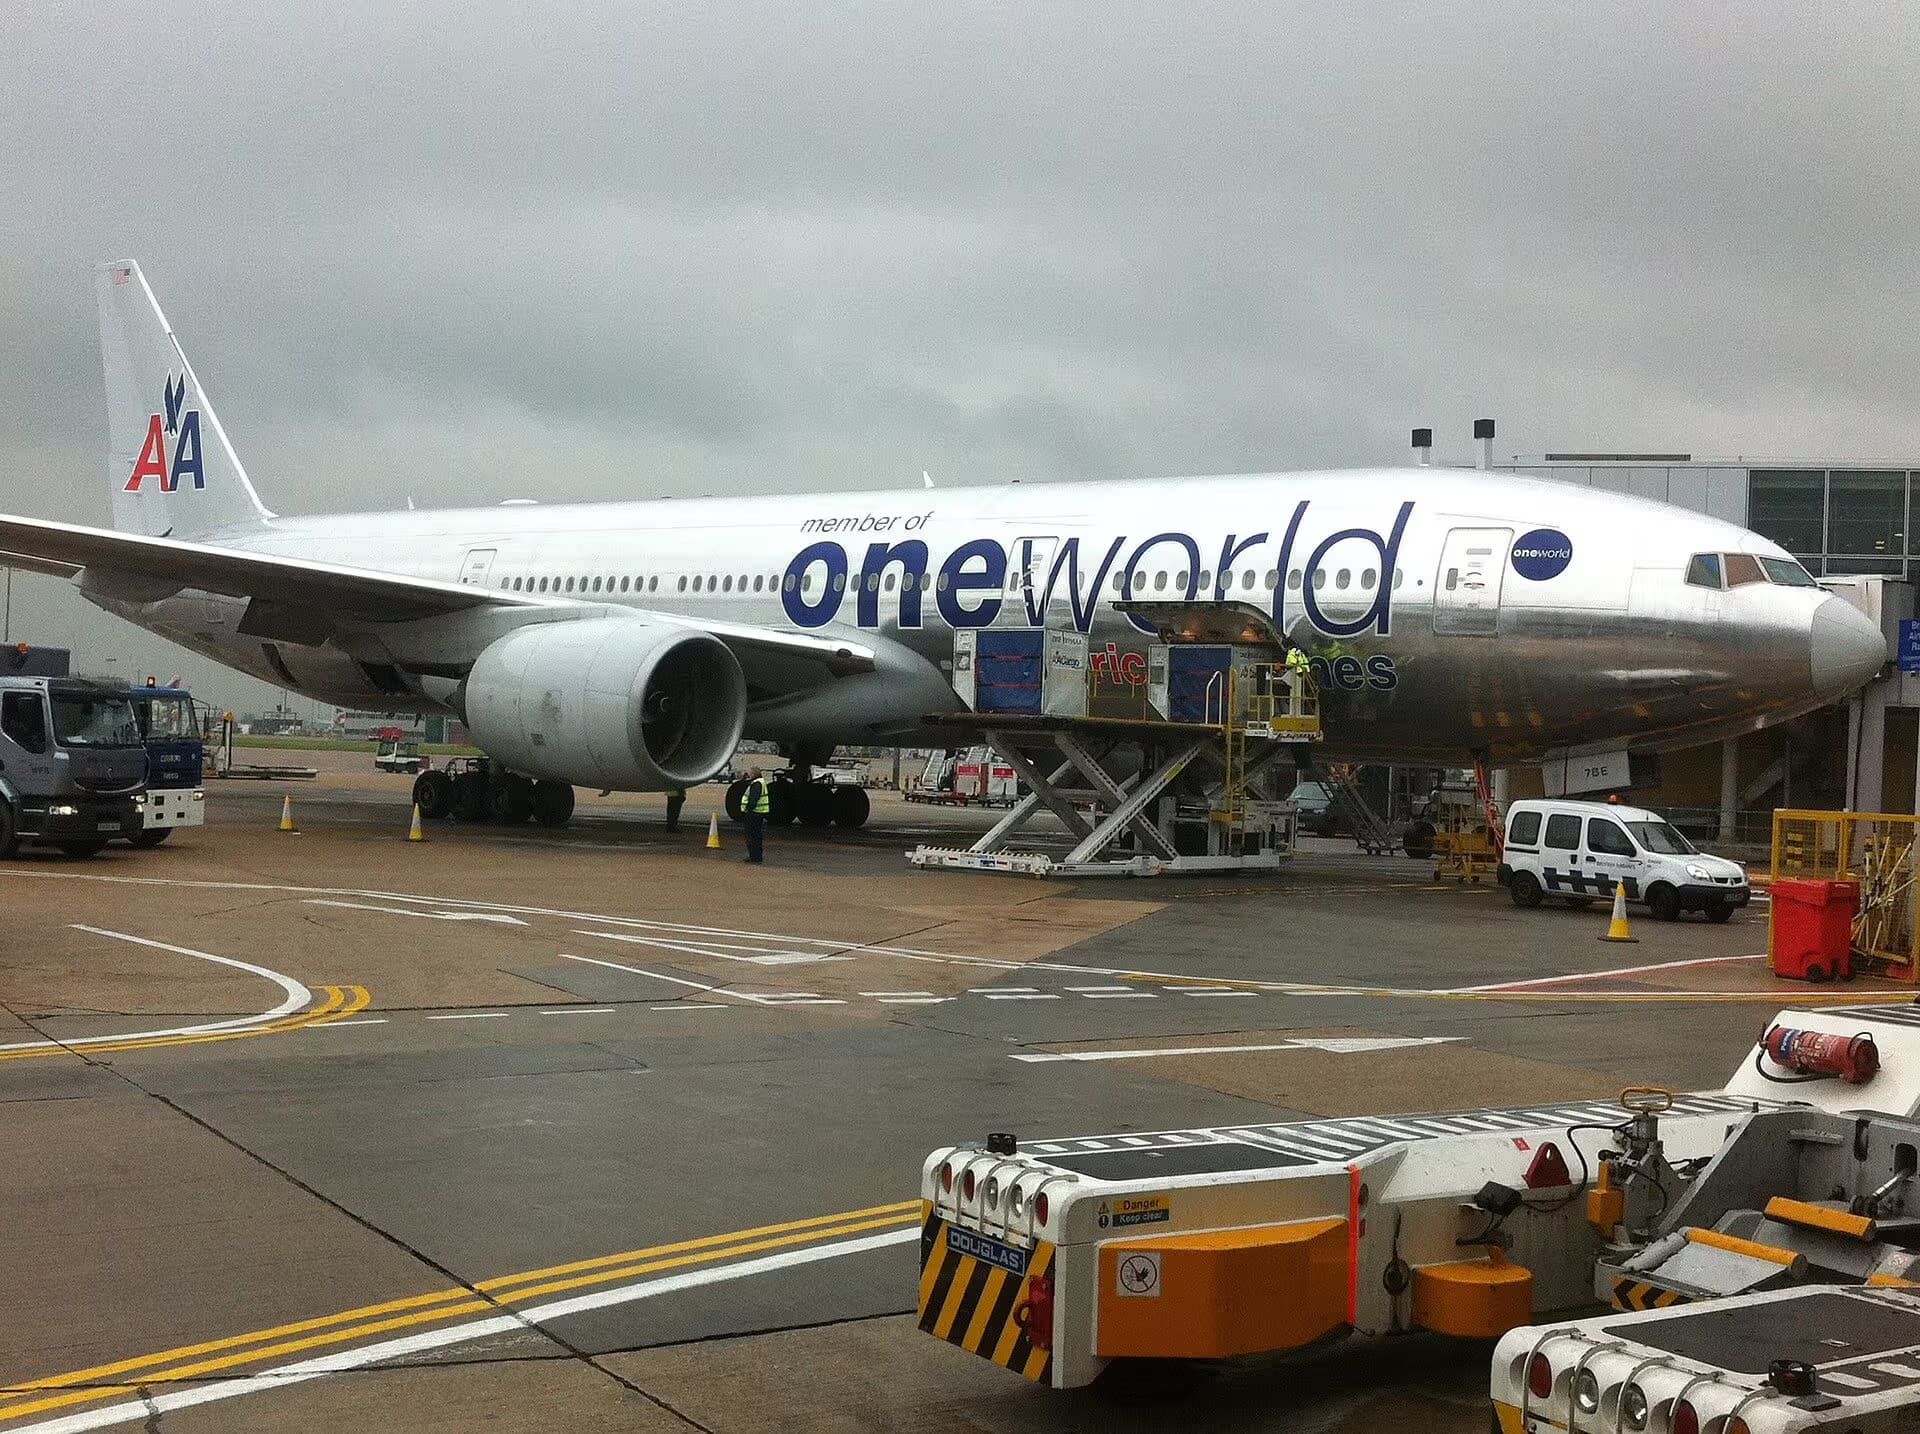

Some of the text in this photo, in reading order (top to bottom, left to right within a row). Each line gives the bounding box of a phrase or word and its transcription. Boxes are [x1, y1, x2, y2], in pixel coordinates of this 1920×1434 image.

[800, 510, 935, 533] member of
[1513, 548, 1571, 559] oneworld
[781, 500, 1416, 637] oneworld
[1123, 1200, 1159, 1210] Danger
[950, 1230, 1020, 1268] DOUGLAS
